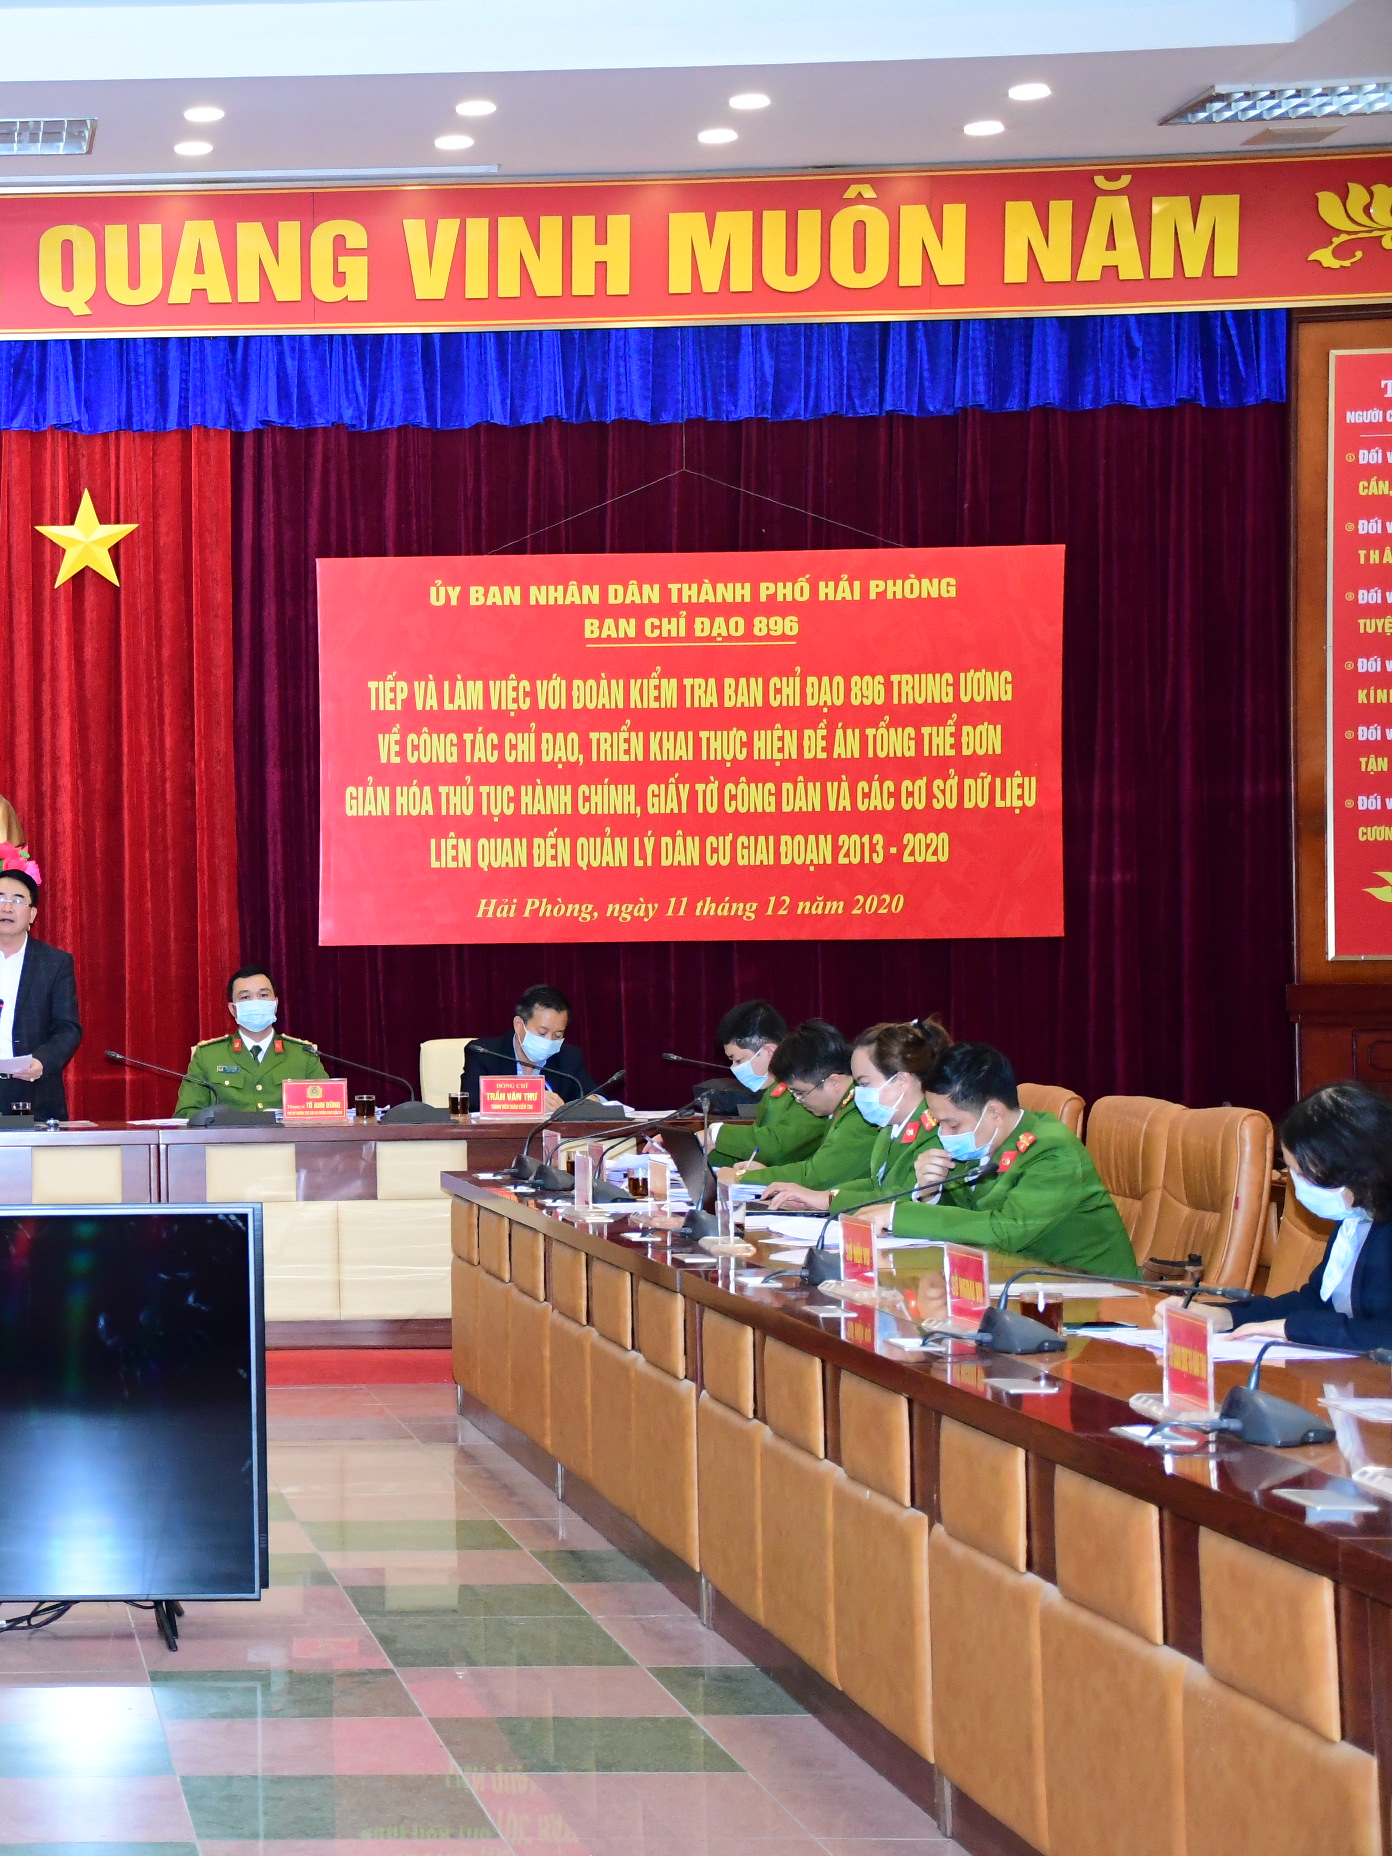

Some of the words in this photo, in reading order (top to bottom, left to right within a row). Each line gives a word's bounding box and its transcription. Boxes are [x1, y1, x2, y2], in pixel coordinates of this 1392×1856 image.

[40, 220, 368, 315] QUANG
[405, 215, 630, 299] VINH
[669, 185, 966, 293] MUÔN
[1005, 177, 1239, 283] NĂM
[1346, 408, 1383, 423] NGƯỜI
[1359, 447, 1382, 464] Đối
[1358, 517, 1382, 534] Đối
[430, 580, 461, 606] ỦY
[470, 586, 521, 605] BAN
[530, 581, 599, 605] NHÂN
[608, 580, 659, 604] DÂN
[668, 579, 750, 603] THÀNH
[760, 575, 810, 602] PHỐ
[819, 574, 860, 601] HẢI
[870, 574, 956, 599] PHÒNG
[1358, 587, 1382, 604] Đối
[585, 618, 635, 638] BAN
[645, 611, 686, 637] CHỈ
[694, 617, 744, 641] ĐẠO
[753, 616, 798, 636] 896
[1357, 656, 1381, 672] Đối
[368, 671, 408, 710] TIẾP
[414, 674, 438, 710] VÀ
[444, 674, 483, 710] LÀM
[489, 674, 530, 716] VIỆC
[536, 673, 566, 709] VỚI
[572, 673, 623, 709] ĐOÀN
[630, 666, 677, 708] KIỂM
[683, 678, 718, 707] TRA
[724, 678, 762, 707] BAN
[769, 666, 800, 707] CHỈ
[806, 676, 844, 712] ĐẠO
[851, 675, 884, 705] 896
[891, 673, 953, 704] TRUNG
[960, 669, 1012, 702] ƯƠNG
[1358, 687, 1392, 704] KÍN
[378, 724, 400, 763] VỀ
[407, 727, 457, 763] CÔNG
[463, 727, 498, 763] TÁC
[505, 722, 535, 762] CHỈ
[541, 732, 583, 768] ĐẠO,
[589, 719, 643, 761] TRIỂN
[650, 731, 693, 761] KHAI
[699, 728, 747, 767] THỰC
[754, 724, 797, 766] HIỆN
[803, 719, 827, 759] ĐỀ
[833, 723, 859, 758] ÁN
[866, 716, 915, 758] TỔNG
[921, 714, 957, 756] THỂ
[962, 722, 1001, 755] ĐƠN
[1358, 724, 1382, 740] Đối
[1359, 755, 1388, 774] TẬN
[345, 776, 390, 816] GIẢN
[396, 780, 433, 816] HÓA
[439, 776, 474, 815] THỦ
[479, 785, 514, 822] TỤC
[521, 779, 571, 815] HÀNH
[578, 778, 640, 817] CHÍNH,
[647, 773, 689, 814] GIẤY
[695, 776, 718, 813] TỜ
[724, 777, 775, 813] CÔNG
[782, 776, 820, 812] DÂN
[827, 775, 851, 811] VÀ
[857, 775, 894, 811] CÁC
[901, 777, 926, 810] CƠ
[933, 769, 958, 809] SỞ
[964, 772, 991, 808] DỮ
[996, 771, 1036, 813] LIỆU
[1358, 793, 1382, 810] Đối
[431, 832, 471, 868] LIÊN
[478, 838, 527, 871] QUAN
[533, 828, 570, 867] ĐẾN
[577, 827, 627, 870] QUẢN
[634, 831, 655, 866] LÝ
[661, 830, 699, 866] DÂN
[706, 833, 732, 866] CƯ
[737, 836, 774, 865] GIAI
[780, 835, 832, 871] ĐOẠN
[838, 834, 883, 864] 2013
[903, 832, 948, 862] 2020
[476, 899, 517, 917] Hải
[523, 898, 598, 922] Phòng,
[606, 898, 658, 922] ngày
[667, 897, 687, 915] 11
[696, 897, 758, 921] tháng
[767, 896, 790, 914] 12
[797, 896, 844, 914] năm
[852, 894, 904, 914] 2020
